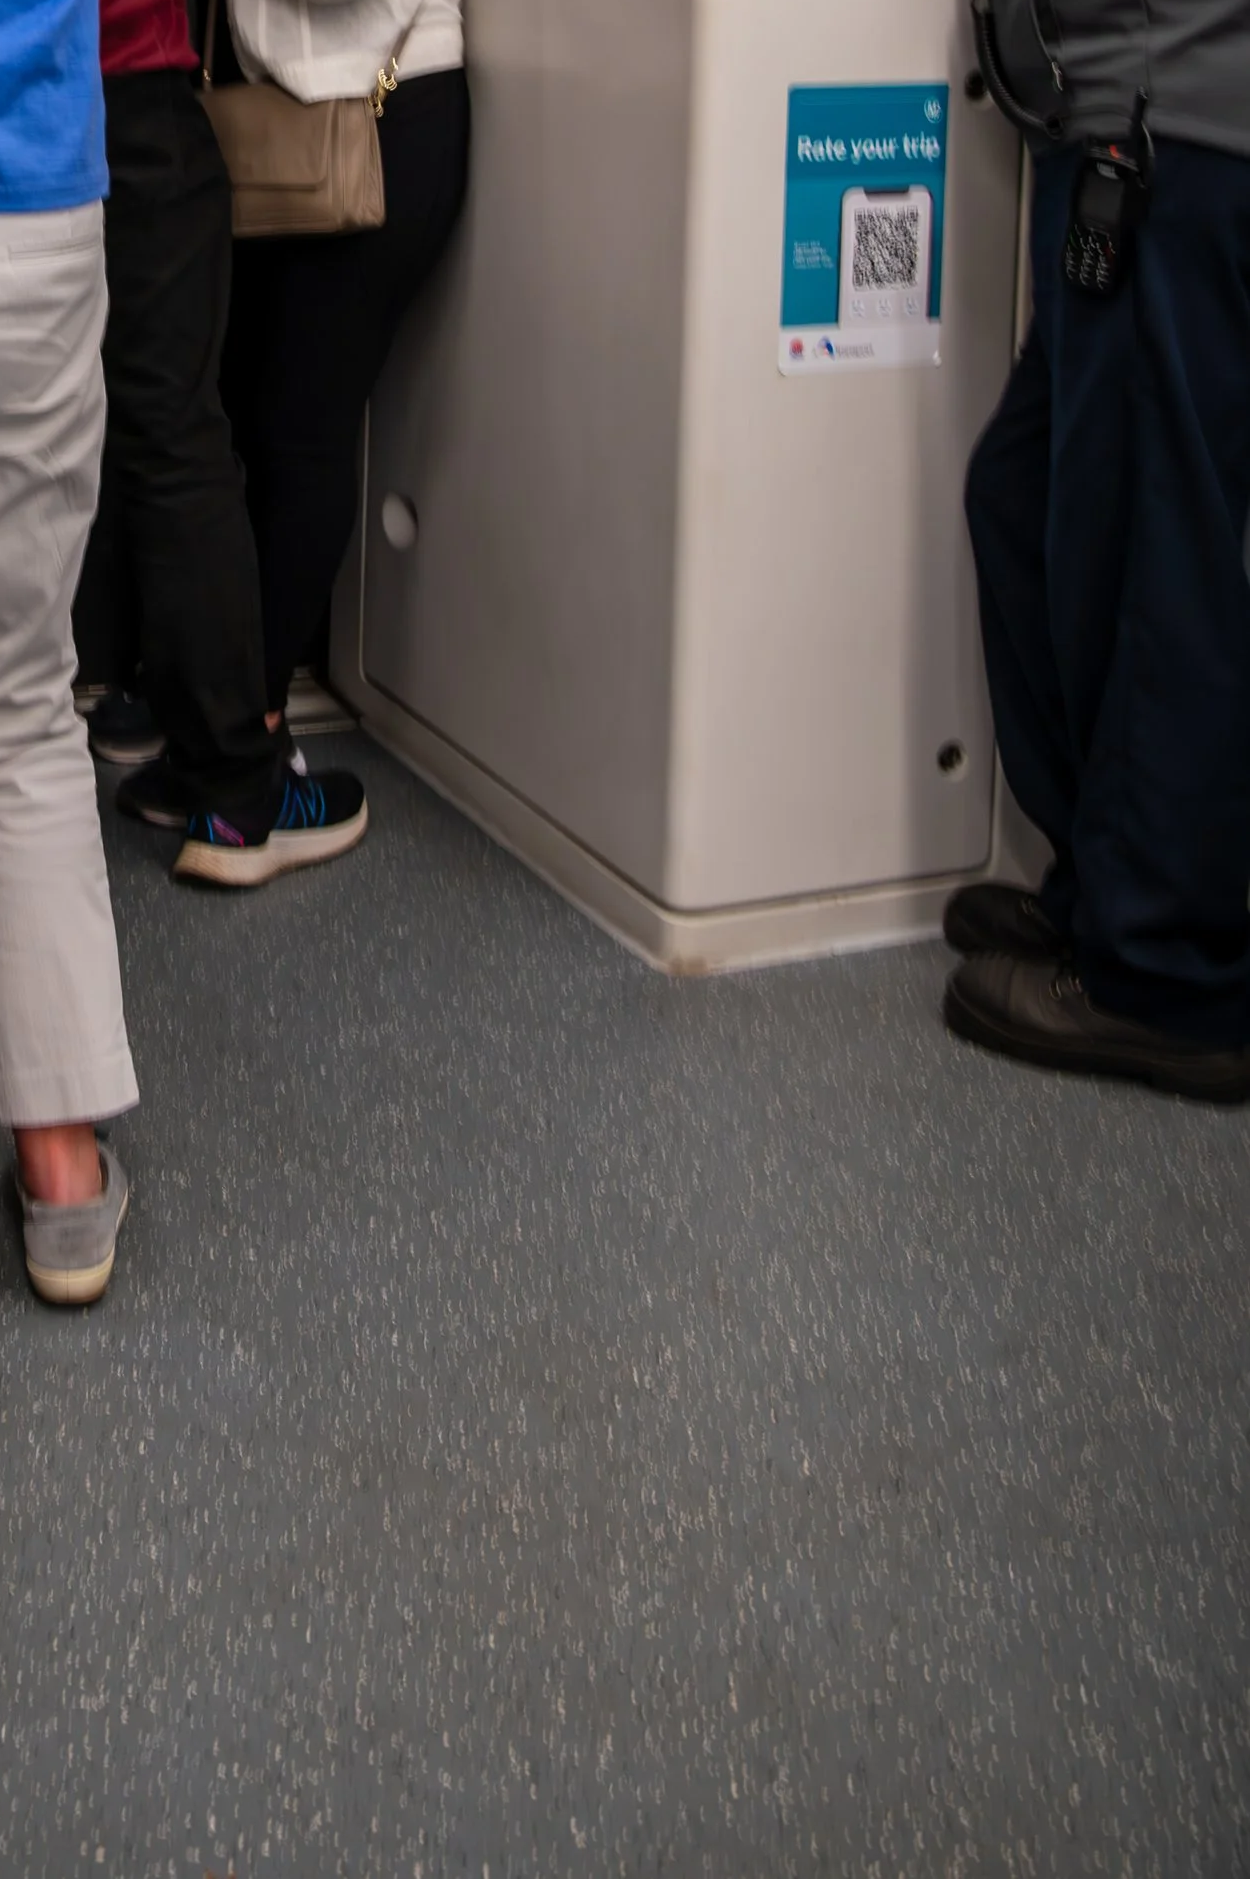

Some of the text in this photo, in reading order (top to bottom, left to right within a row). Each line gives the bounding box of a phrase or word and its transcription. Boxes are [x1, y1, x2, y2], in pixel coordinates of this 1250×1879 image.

[798, 131, 941, 165] Rate your trip
